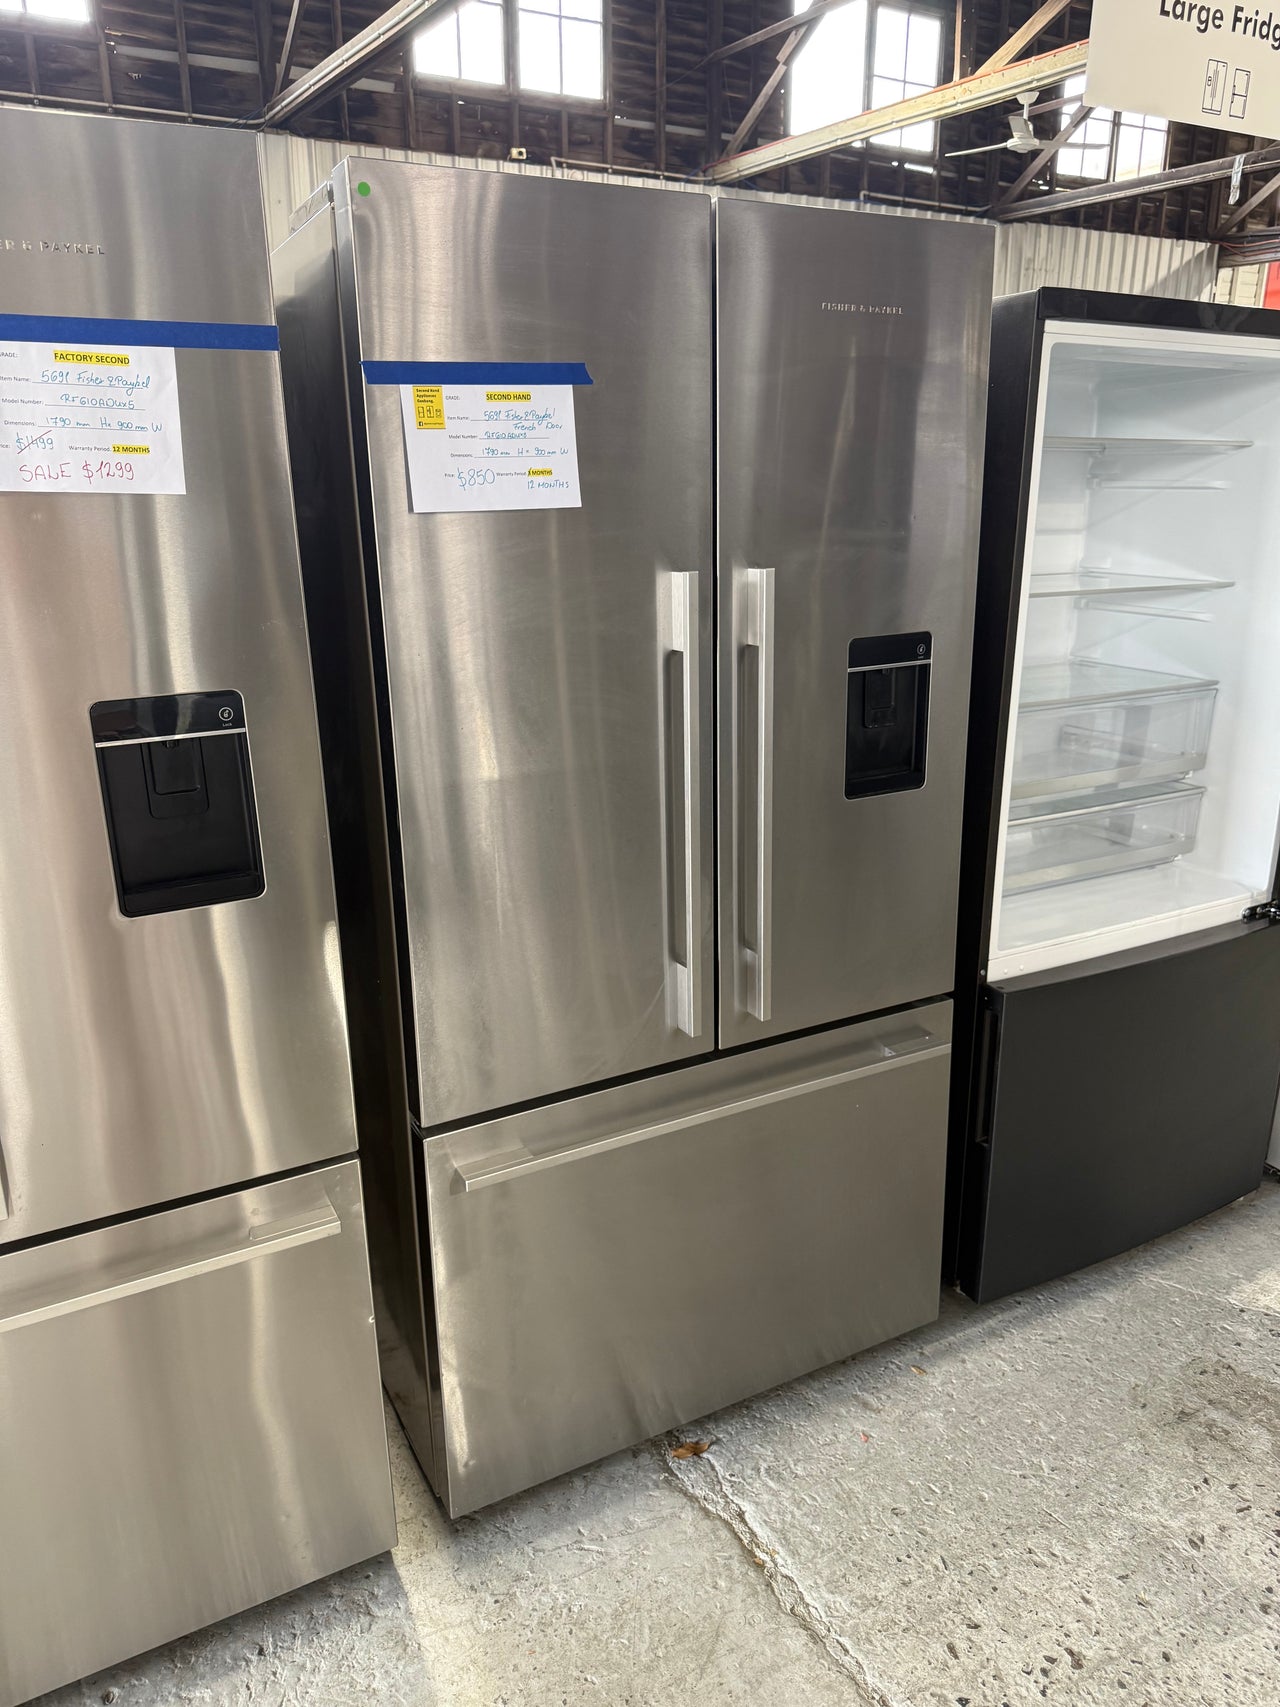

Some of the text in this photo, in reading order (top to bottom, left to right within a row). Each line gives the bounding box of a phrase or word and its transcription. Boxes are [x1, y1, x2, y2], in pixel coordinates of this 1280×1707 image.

[1160, 0, 1224, 33] Large
[40, 241, 105, 255] PAYKEL
[821, 302, 857, 312] FISHER
[869, 305, 904, 315] PAYKEL
[54, 352, 130, 365] FACTORY SECOND
[77, 370, 104, 385] Fisher
[486, 393, 532, 401] SECOND HAND
[46, 417, 71, 427] 1790
[117, 420, 133, 430] 900
[152, 422, 163, 432] W
[513, 421, 536, 431] French
[112, 445, 121, 453] 12
[121, 446, 150, 454] MONTHS
[482, 447, 499, 456] 1790
[517, 447, 524, 455] H
[534, 447, 546, 456] 900
[560, 447, 569, 455] W
[19, 460, 135, 484] SALE $1299
[457, 467, 496, 491] $850
[527, 480, 569, 489] 12 MONTHS
